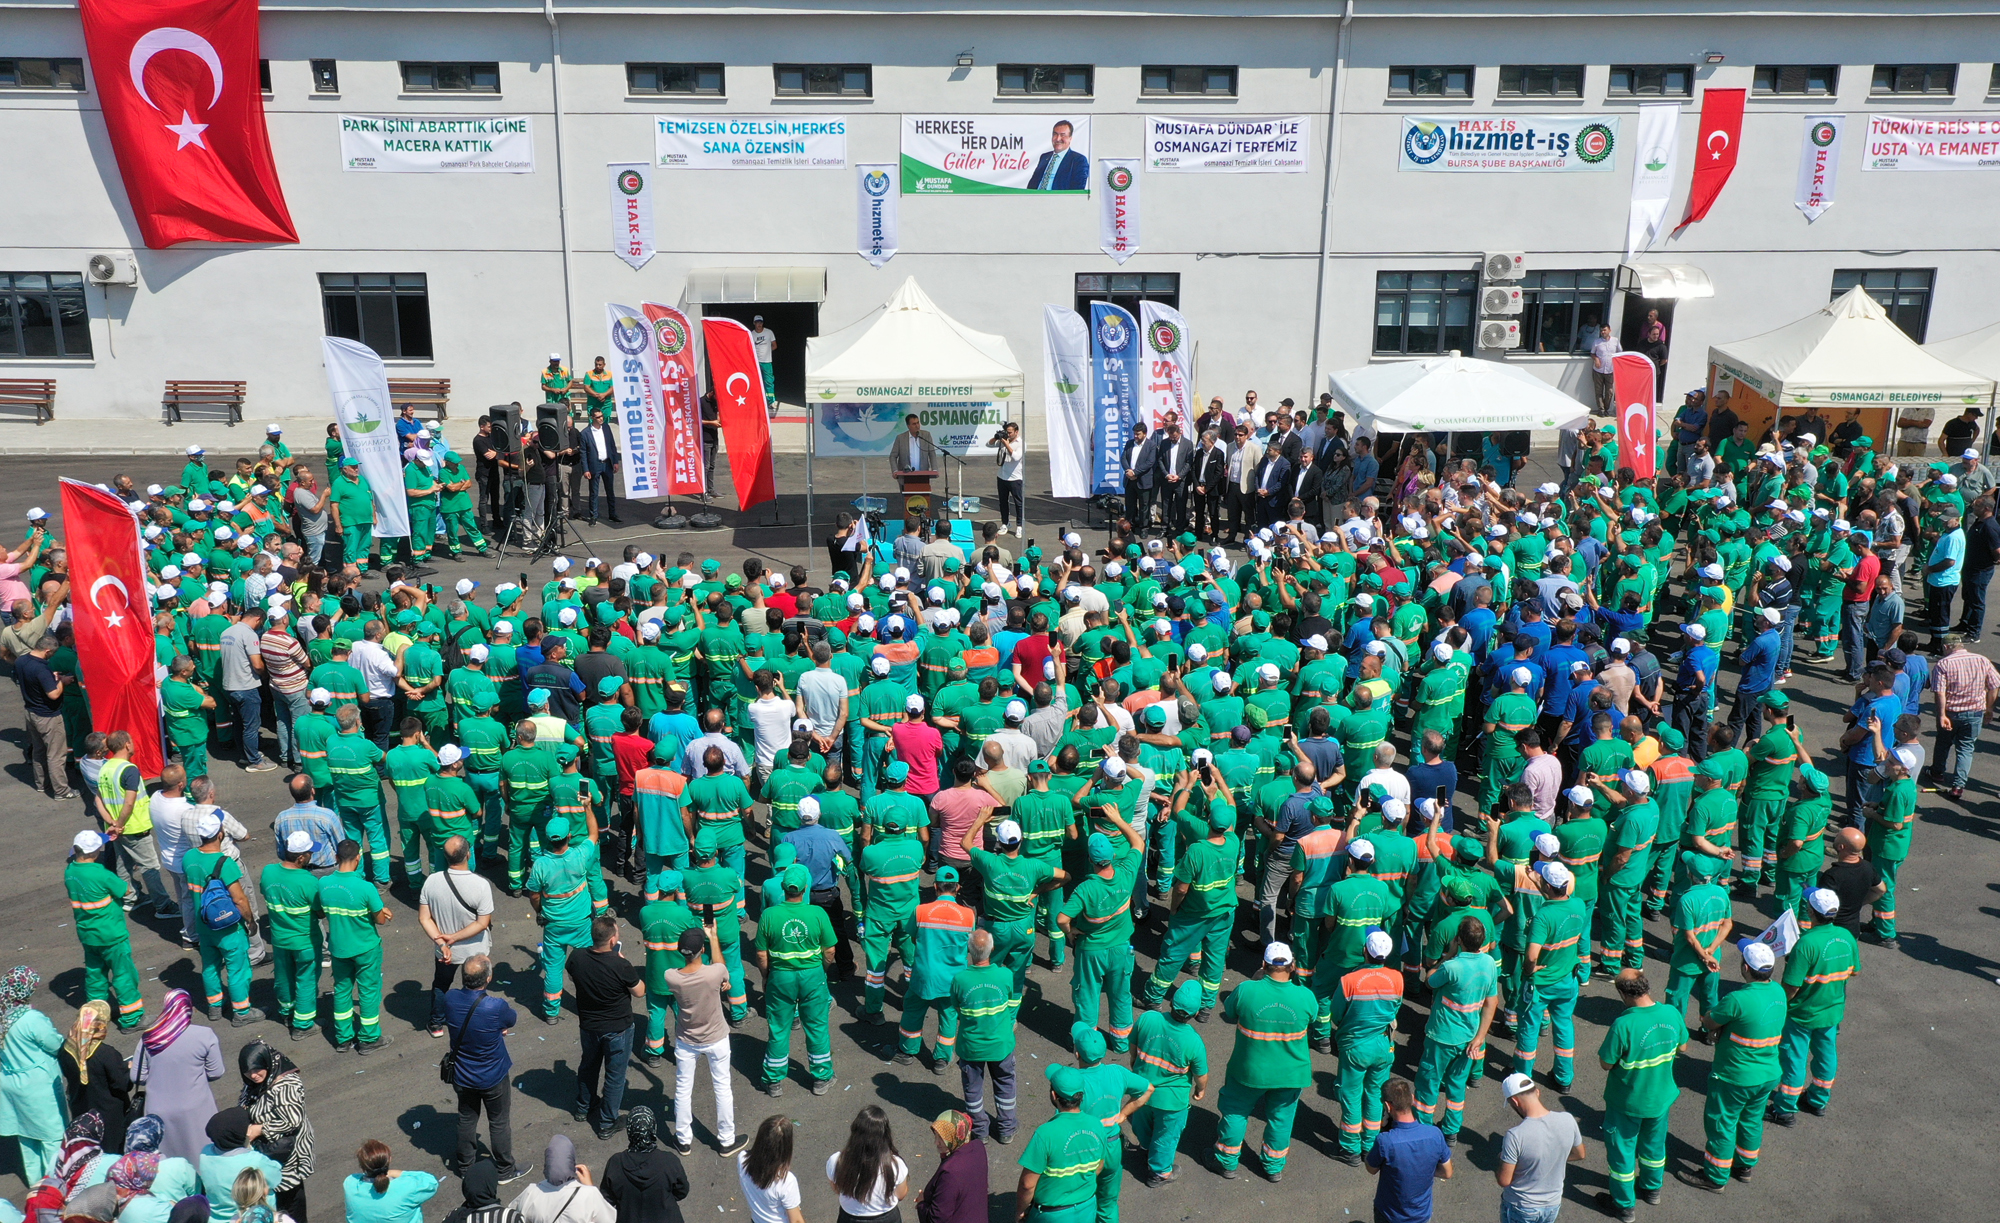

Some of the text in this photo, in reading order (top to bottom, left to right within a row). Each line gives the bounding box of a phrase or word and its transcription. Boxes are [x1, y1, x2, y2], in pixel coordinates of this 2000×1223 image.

[343, 118, 526, 134] PARK İŞİNİ ABARTTIK İÇİNE
[658, 120, 726, 134] TEMİZSEN
[916, 120, 974, 134] HERKESE
[1156, 123, 1214, 135] MUSTAFA
[1459, 119, 1516, 134] HAK-İŞ
[1872, 118, 1934, 134] TÜRKİYE
[384, 140, 493, 152] MACERA KATTIK
[703, 139, 805, 154] SANA ÖZENSİN
[962, 133, 1024, 150] HER DAİM
[1154, 138, 1298, 152] OSMANGAZİ TERTEMİZ
[1450, 126, 1570, 157] hizmet-iş
[1939, 142, 1999, 155] EMANET
[944, 151, 1030, 170] Güler Yüzle
[1482, 160, 1506, 168] ŞUBE
[1509, 159, 1565, 168] BAŞKANLIĞI
[1806, 150, 1828, 207] HAK-İŞ
[627, 199, 642, 256] HAK-İŞ
[870, 199, 884, 256] hizmet-iş
[1113, 195, 1128, 251] HAK-İŞ
[857, 384, 973, 396] OSMANGAZİ BELEDİYESİ
[1830, 391, 1942, 402] OSMANGAZİ BELEDİYESİ
[1120, 372, 1130, 428] BAŞKANLIĞI
[623, 359, 649, 491] hizmet-iş
[1100, 357, 1124, 488] hizmet-iş
[1487, 415, 1533, 423] BELEDİYESİ
[642, 374, 658, 489] BURSA ŞUBE BAŞKANLIĞI
[682, 378, 697, 483] BURSA İL BAŞKANLIĞI
